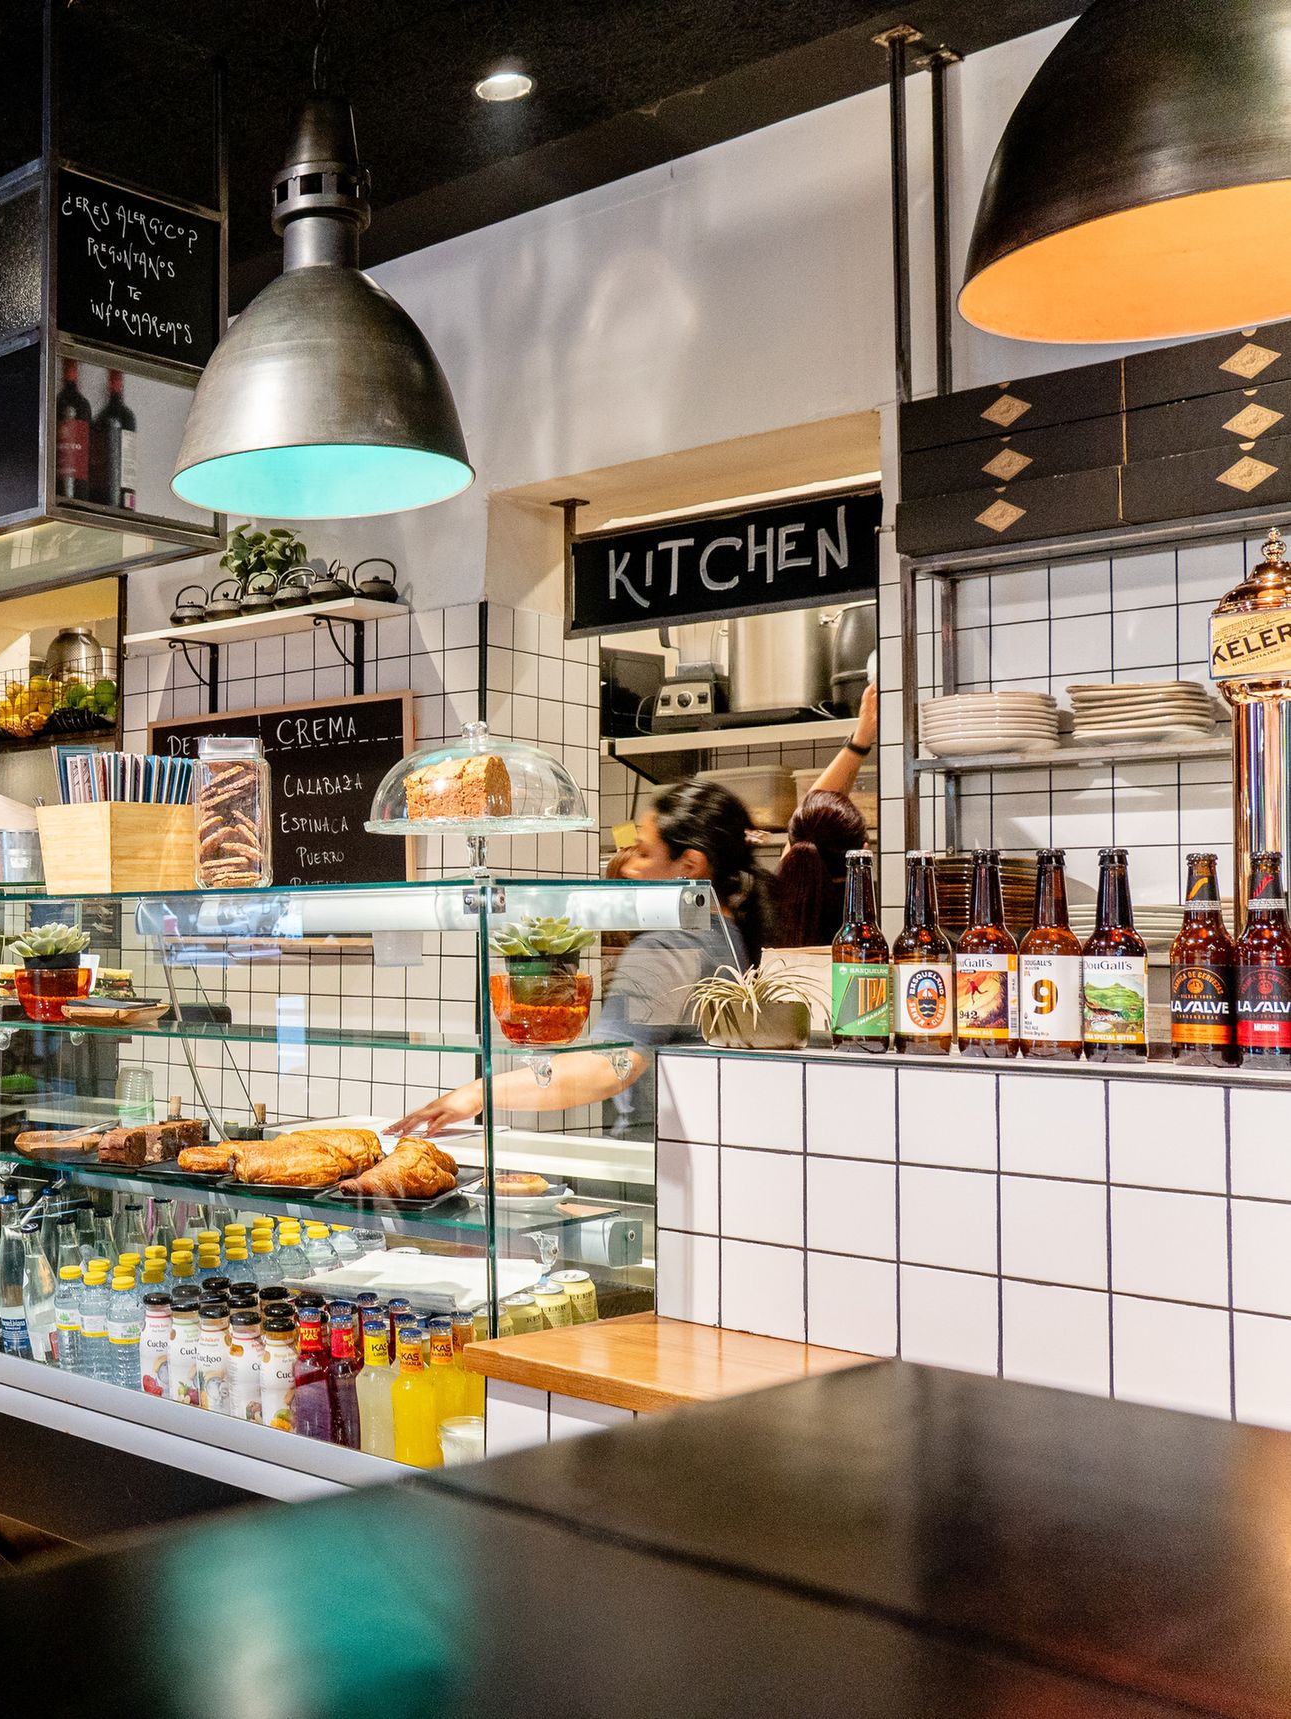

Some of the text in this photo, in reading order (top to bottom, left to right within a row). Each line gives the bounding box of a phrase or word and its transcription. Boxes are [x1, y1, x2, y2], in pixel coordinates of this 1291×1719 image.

[87, 237, 175, 280] PREGUNTANOS
[109, 279, 142, 301] Y TE
[608, 505, 848, 608] KITCHEN
[1213, 623, 1291, 665] KELER
[276, 716, 356, 745] CREMA
[283, 773, 363, 798] CALABAZA
[280, 812, 349, 834] ESPINACA
[295, 846, 345, 867] PUERRO
[957, 958, 993, 968] uGall's
[857, 977, 887, 1017] IPA
[1032, 978, 1058, 1014] 9
[1238, 1000, 1291, 1013] LA SALV
[959, 1010, 978, 1019] 942
[1171, 1000, 1230, 1015] LA SALVE
[1254, 1023, 1279, 1032] MUNICH
[146, 1340, 168, 1349] Cucko
[433, 1343, 451, 1352] KAS
[401, 1352, 420, 1361] KAS
